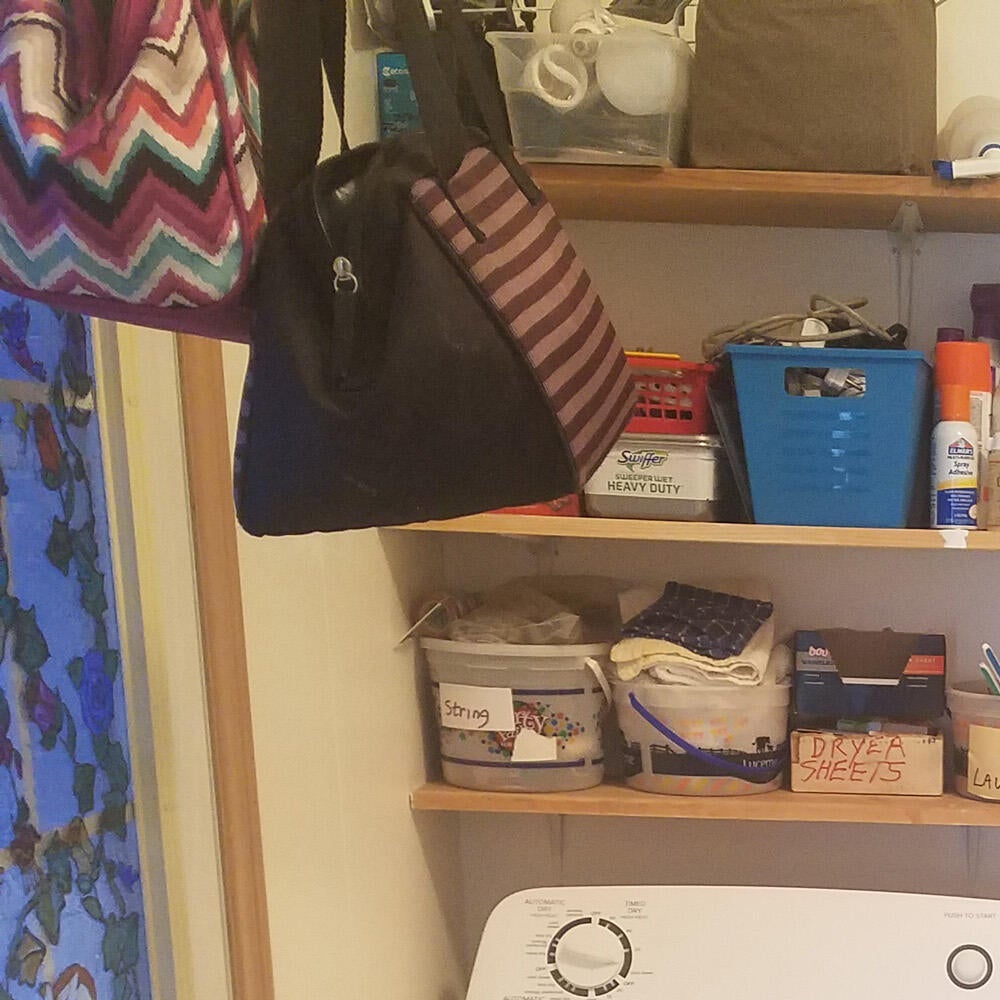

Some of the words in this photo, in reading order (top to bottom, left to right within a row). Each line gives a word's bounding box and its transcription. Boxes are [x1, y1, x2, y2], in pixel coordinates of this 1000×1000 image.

[617, 450, 665, 468] Swiffer
[953, 461, 970, 469] Spray
[615, 473, 652, 481] SWEEPER
[607, 481, 647, 492] HEAVY
[649, 483, 681, 494] DUTY
[444, 700, 490, 729] String
[801, 759, 906, 784] SHEETS
[965, 911, 974, 919] TO
